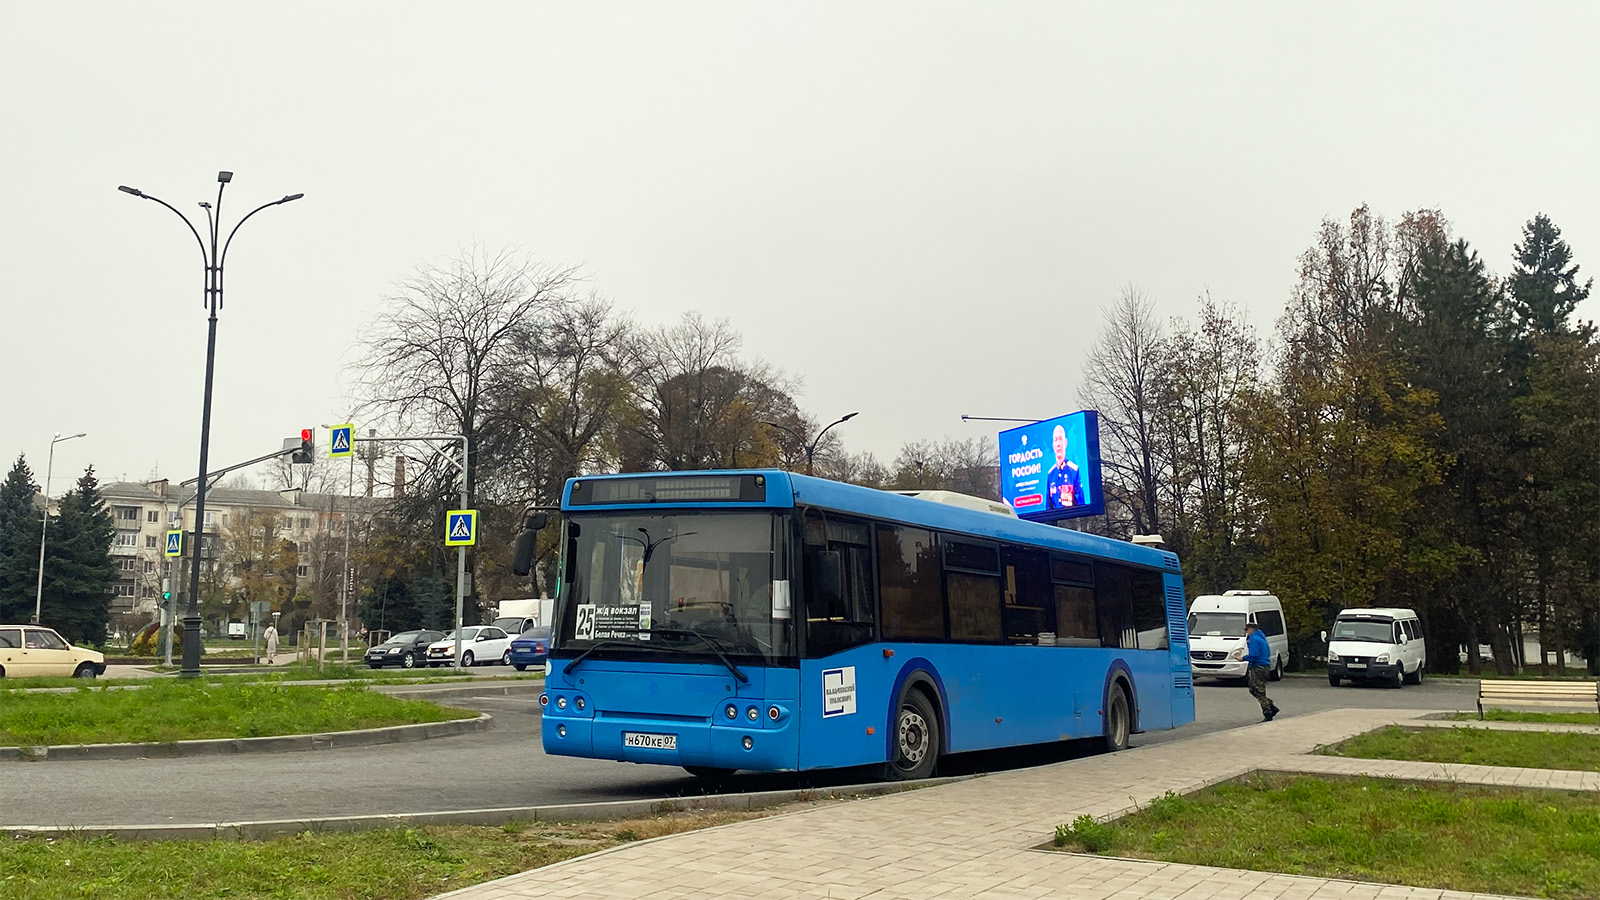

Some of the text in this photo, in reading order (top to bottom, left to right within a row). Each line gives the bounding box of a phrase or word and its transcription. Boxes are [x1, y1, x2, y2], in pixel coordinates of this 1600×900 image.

[1008, 448, 1043, 464] ГОРДОСТЬ
[1011, 463, 1041, 478] РОССИИ!
[595, 605, 609, 616] ж/д
[610, 607, 637, 615] вокзал
[576, 607, 594, 636] 25
[595, 630, 610, 638] Белая
[611, 630, 626, 638] Речка
[664, 736, 673, 745] 07
